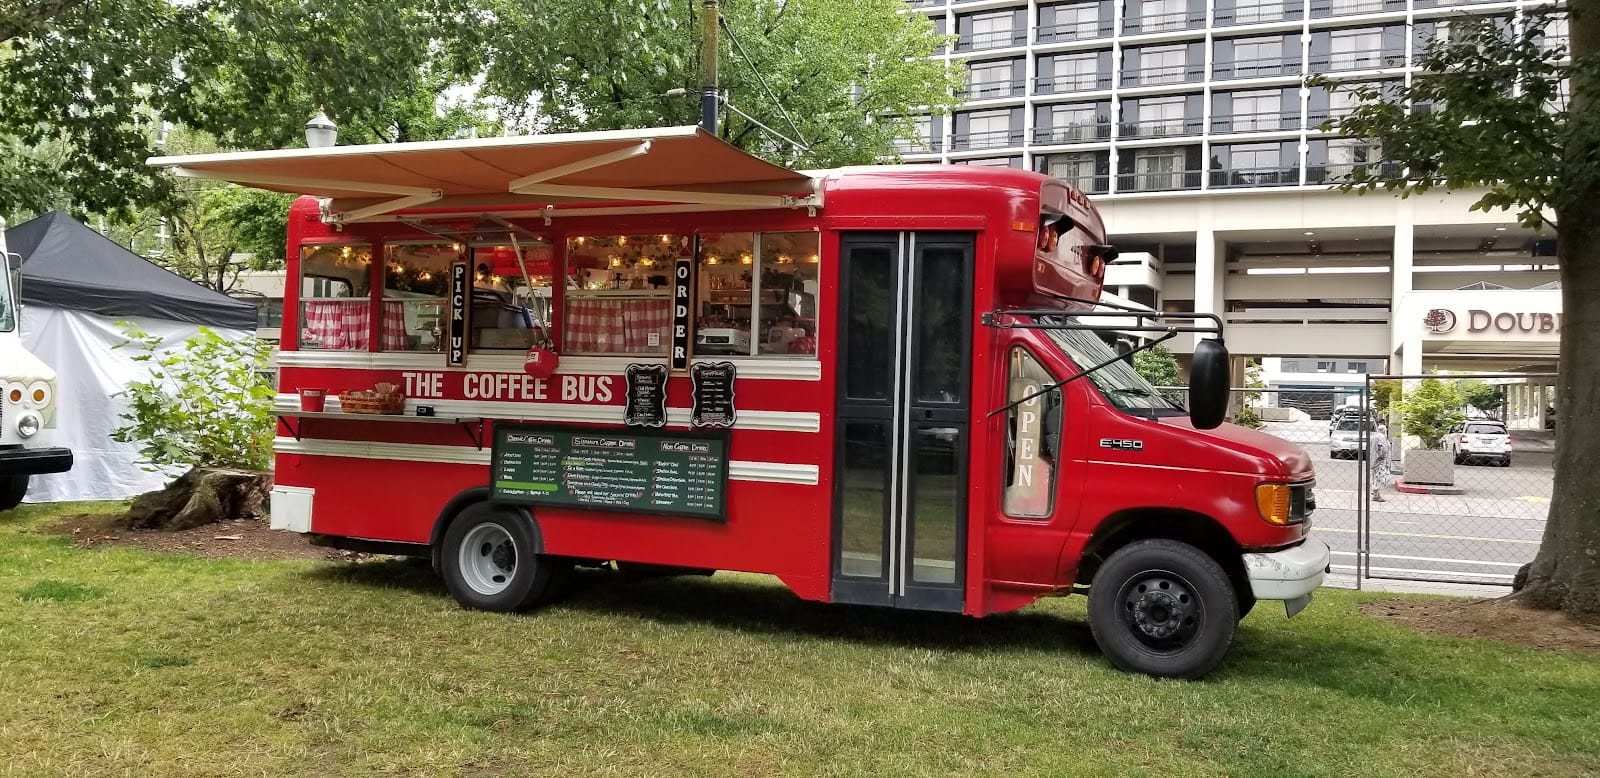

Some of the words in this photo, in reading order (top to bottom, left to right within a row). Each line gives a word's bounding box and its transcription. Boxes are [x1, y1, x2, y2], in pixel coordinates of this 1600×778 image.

[453, 266, 464, 321] PICK
[674, 266, 688, 359] ORDER
[452, 337, 462, 362] UP
[402, 372, 443, 397] THE
[463, 373, 547, 400] COFFEE
[561, 375, 613, 402] BUS
[1018, 384, 1038, 487] OPEN
